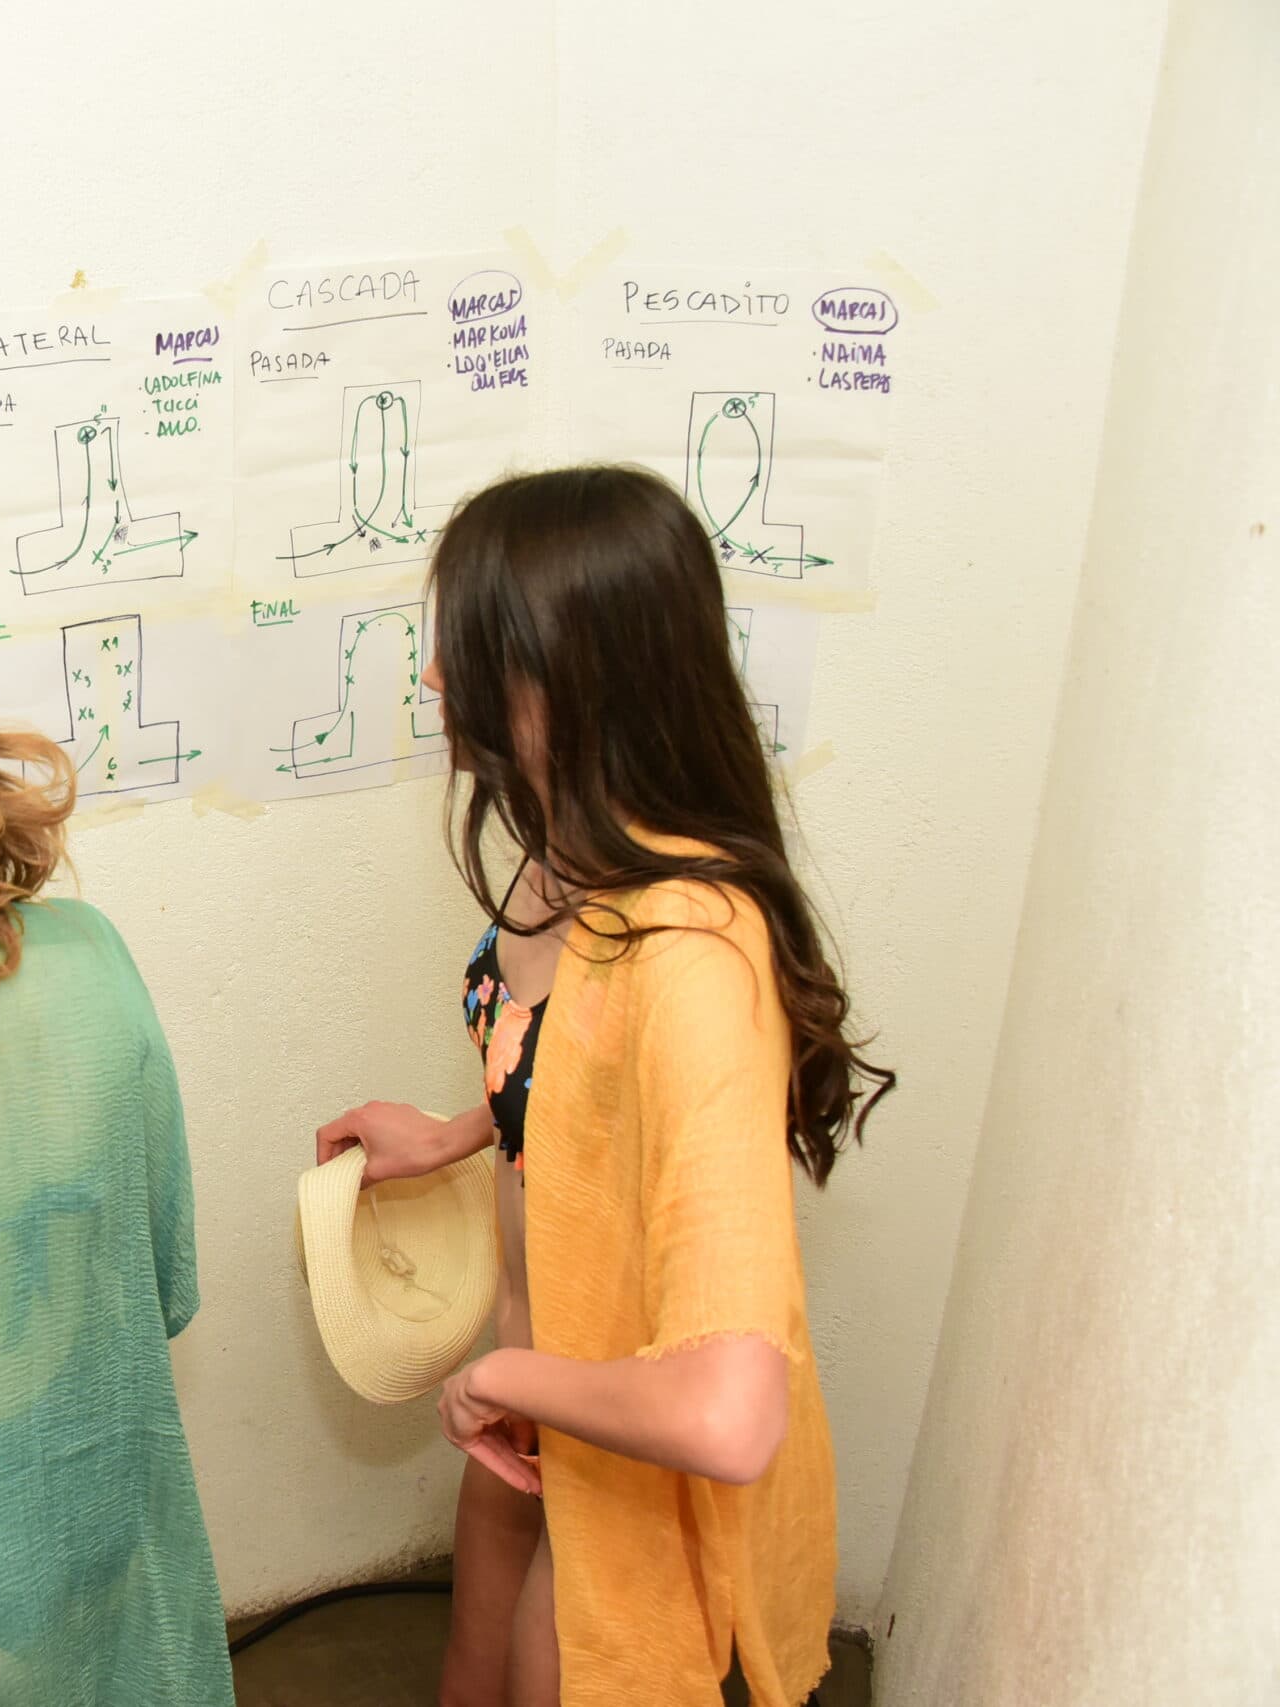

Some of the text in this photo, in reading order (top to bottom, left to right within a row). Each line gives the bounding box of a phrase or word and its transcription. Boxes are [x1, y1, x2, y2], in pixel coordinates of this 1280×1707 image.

[268, 270, 421, 309] CASCADA
[820, 299, 886, 321] MARCAS
[452, 315, 527, 349] MARKOVA
[602, 337, 672, 361] PASADA
[251, 351, 331, 376] PASADA
